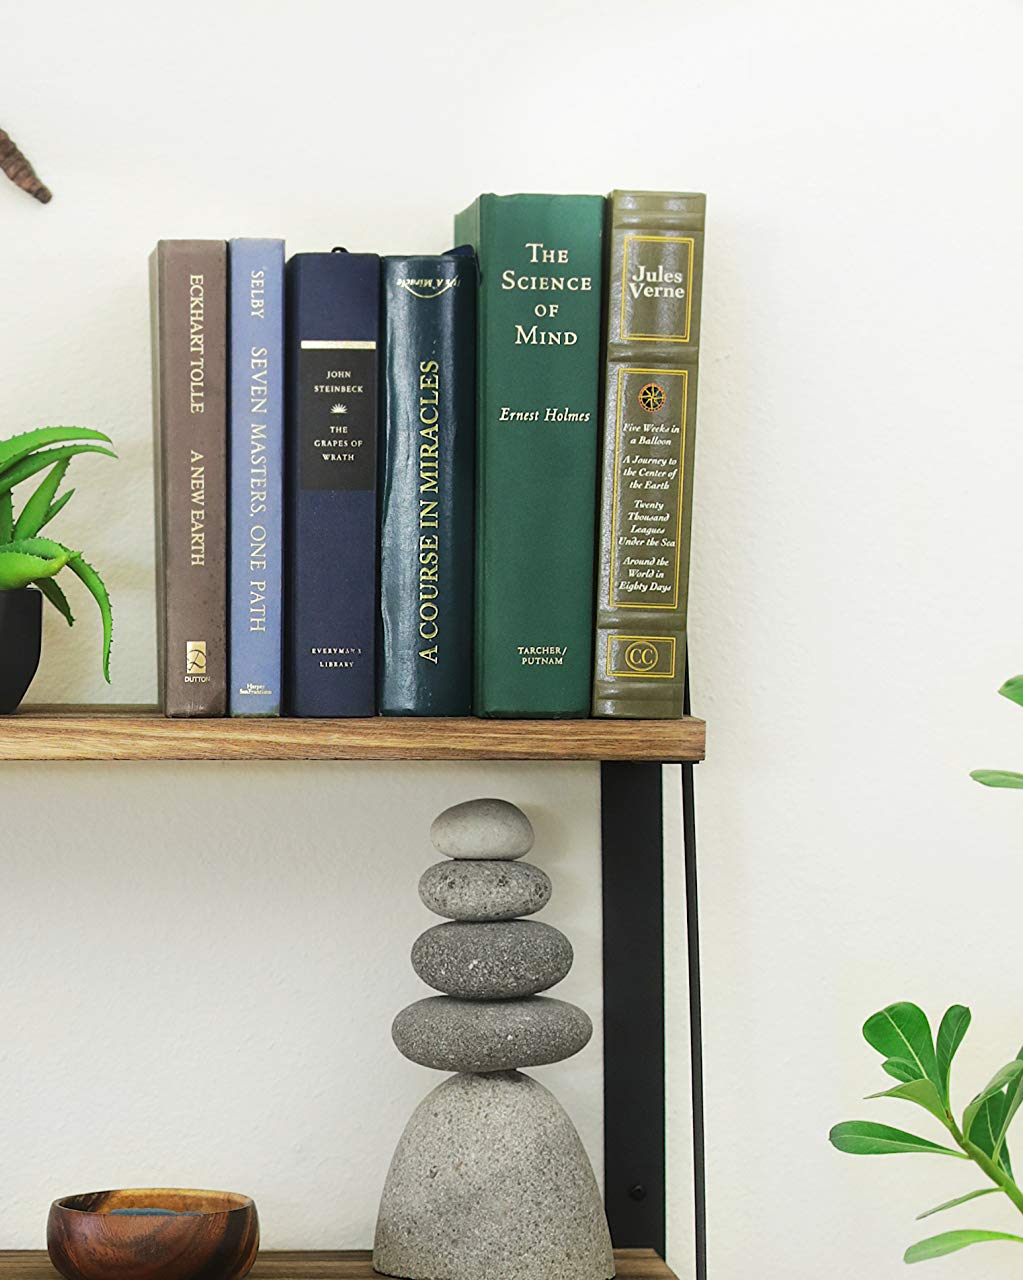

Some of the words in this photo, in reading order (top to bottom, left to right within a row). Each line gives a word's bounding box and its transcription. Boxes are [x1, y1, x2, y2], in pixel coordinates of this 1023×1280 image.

[632, 265, 683, 283] Jules
[250, 270, 265, 319] SELBY
[629, 282, 685, 299] Verne
[190, 274, 204, 355] ECKHART
[250, 347, 267, 414] SEVEN
[326, 371, 352, 379] JOHN
[190, 360, 204, 413] TOLLE
[314, 385, 363, 393] STEINBECK
[499, 407, 539, 422] Ernest
[543, 407, 591, 422] Holmes
[329, 426, 348, 434] THE
[419, 361, 440, 494] MIRACLES
[623, 423, 641, 432] Five
[643, 423, 670, 433] Weeks
[671, 425, 680, 433] in
[314, 439, 348, 448] GRAPES
[350, 439, 363, 448] OF
[638, 435, 672, 445] Balloon
[190, 450, 204, 462] A
[322, 453, 355, 461] WRATH
[622, 455, 630, 464] A
[632, 455, 667, 467] Journey
[250, 423, 267, 517] MASTERS,
[623, 467, 637, 477] the
[638, 467, 667, 477] Center
[667, 469, 678, 480] of
[190, 467, 204, 505] NEW
[629, 480, 643, 489] the
[644, 480, 670, 490] Earth
[634, 499, 664, 511] Twenty
[419, 501, 439, 529] IN
[627, 511, 670, 522] Thousand
[630, 524, 666, 536] Leagues
[190, 510, 205, 566] EARTH
[618, 536, 645, 546] Under
[646, 537, 659, 546] the
[661, 538, 676, 547] Sea
[250, 525, 267, 571] ONE
[622, 556, 656, 565] Around
[656, 557, 669, 566] the
[628, 568, 654, 578] World
[655, 569, 664, 578] in
[419, 535, 439, 640] COURSE
[618, 581, 649, 592] Eighty
[649, 581, 672, 593] Days
[250, 581, 266, 632] PATH
[419, 646, 439, 664] A
[517, 646, 568, 656] TARCHER/
[629, 648, 653, 665] CC
[521, 657, 564, 665] PUTNAM
